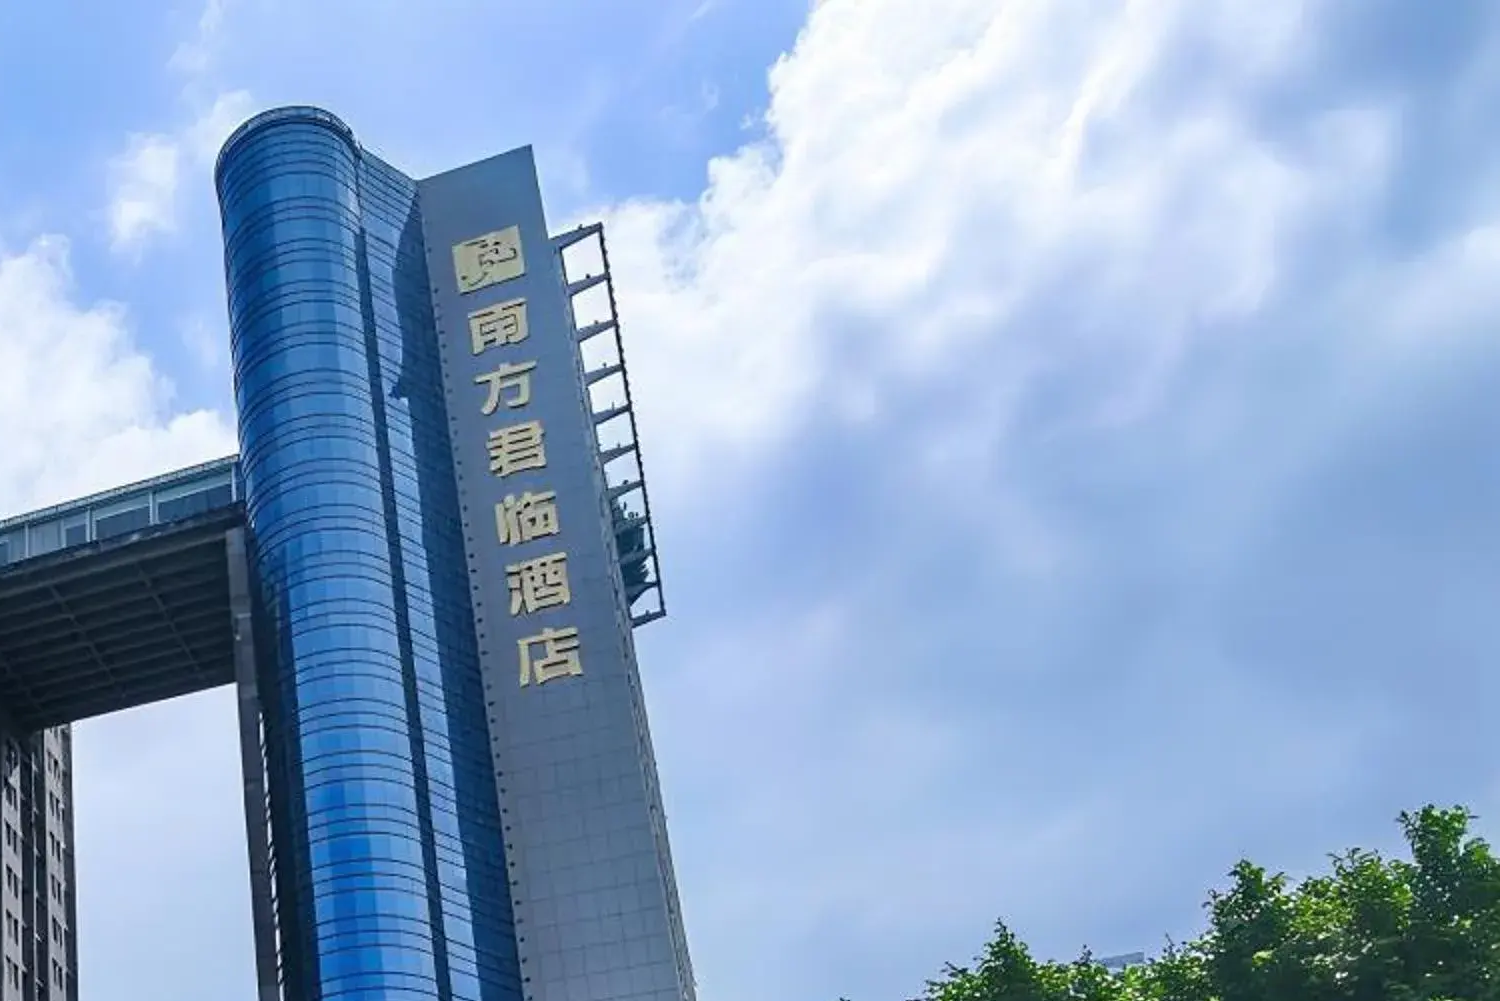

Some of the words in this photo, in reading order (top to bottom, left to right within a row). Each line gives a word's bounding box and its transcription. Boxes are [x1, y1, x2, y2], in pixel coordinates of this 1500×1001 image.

[467, 297, 584, 687] 南方君临酒店
